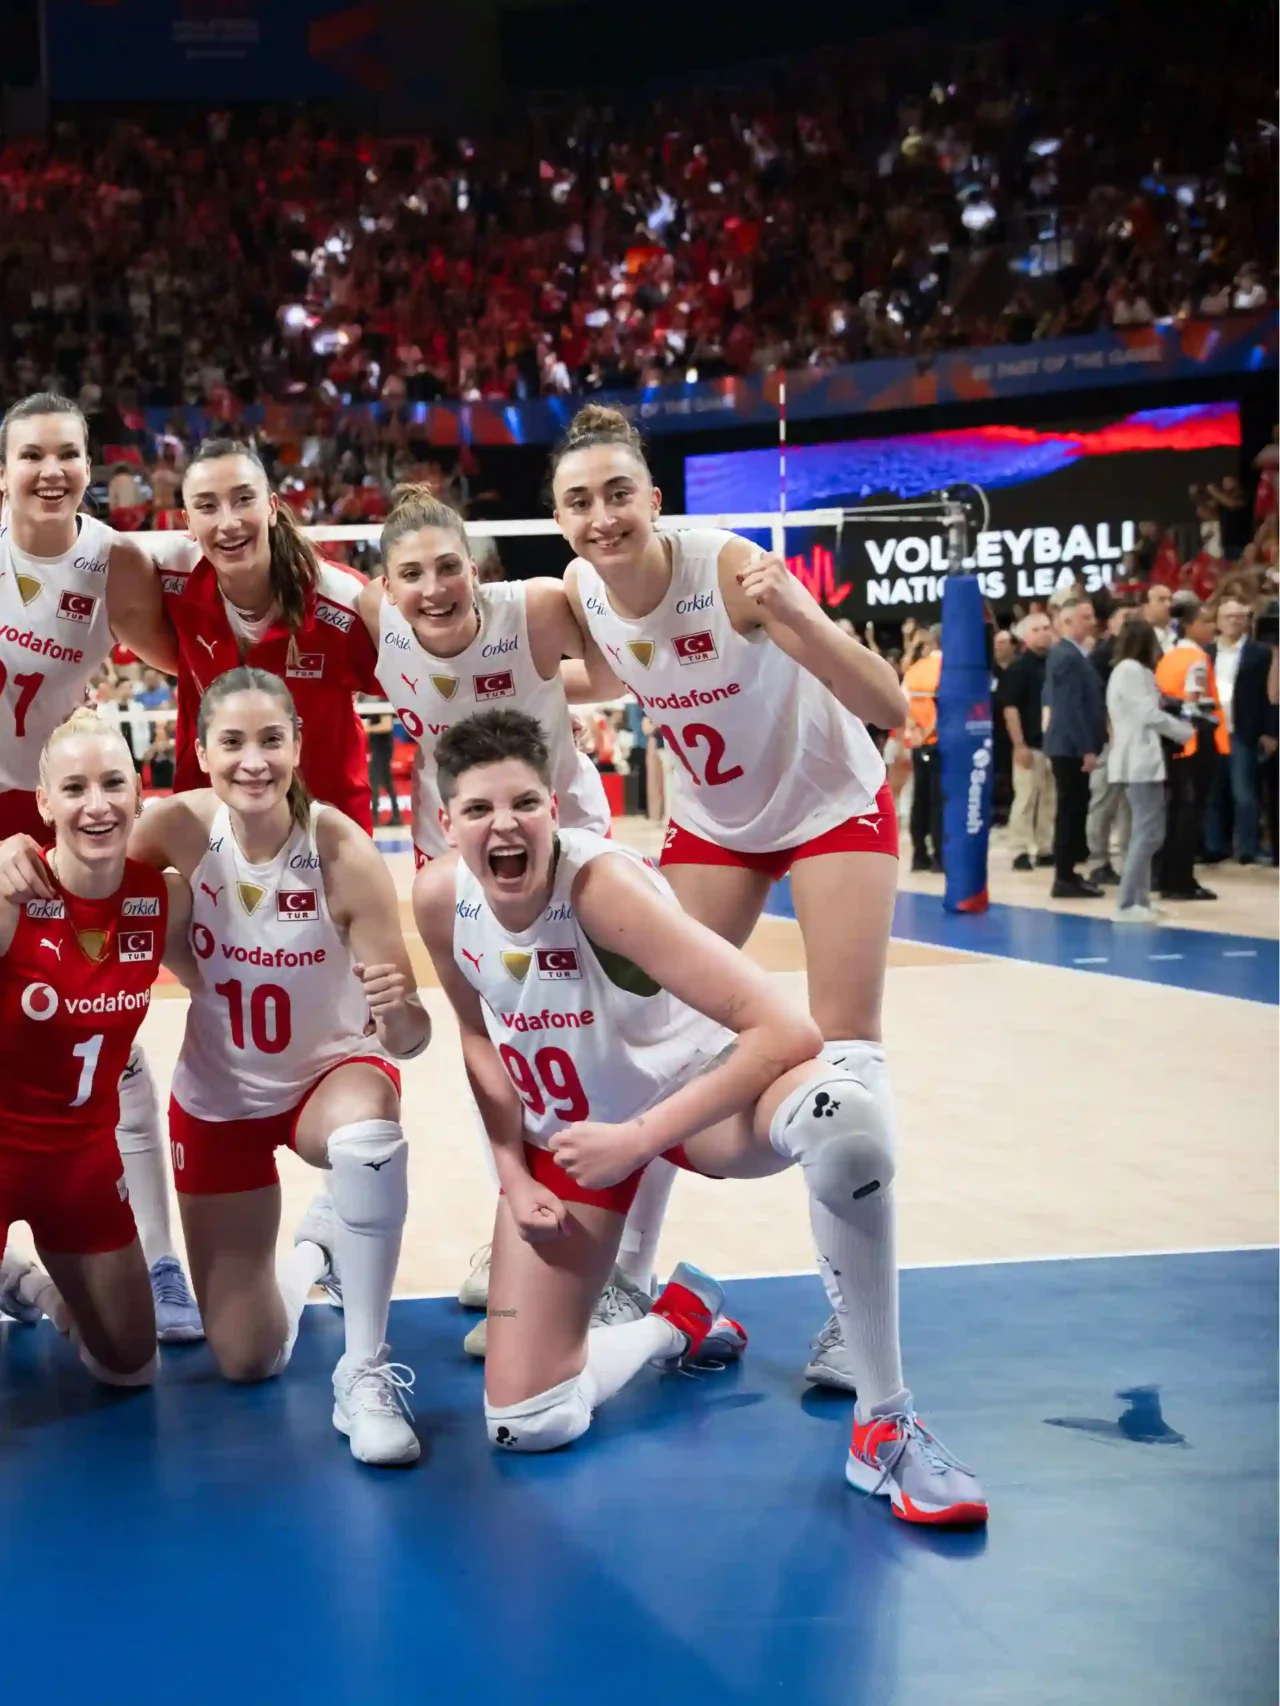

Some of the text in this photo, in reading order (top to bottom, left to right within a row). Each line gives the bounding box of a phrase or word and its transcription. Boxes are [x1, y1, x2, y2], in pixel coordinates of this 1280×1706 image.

[865, 520, 1135, 574] VOLEYBALL
[74, 557, 108, 574] Orkid
[163, 578, 186, 594] Orki
[676, 591, 714, 615] Orkid
[66, 612, 83, 620] TUR
[482, 635, 518, 658] Orkid
[688, 653, 709, 662] TUR
[643, 682, 740, 709] vodafone
[659, 723, 744, 786] 12
[27, 901, 63, 918] Orkid
[123, 898, 157, 916] Orkid
[221, 944, 325, 967] vodafone
[65, 989, 150, 1013] vodafone
[215, 978, 291, 1054] 10
[69, 1034, 104, 1106] 1
[499, 1043, 589, 1122] 99
